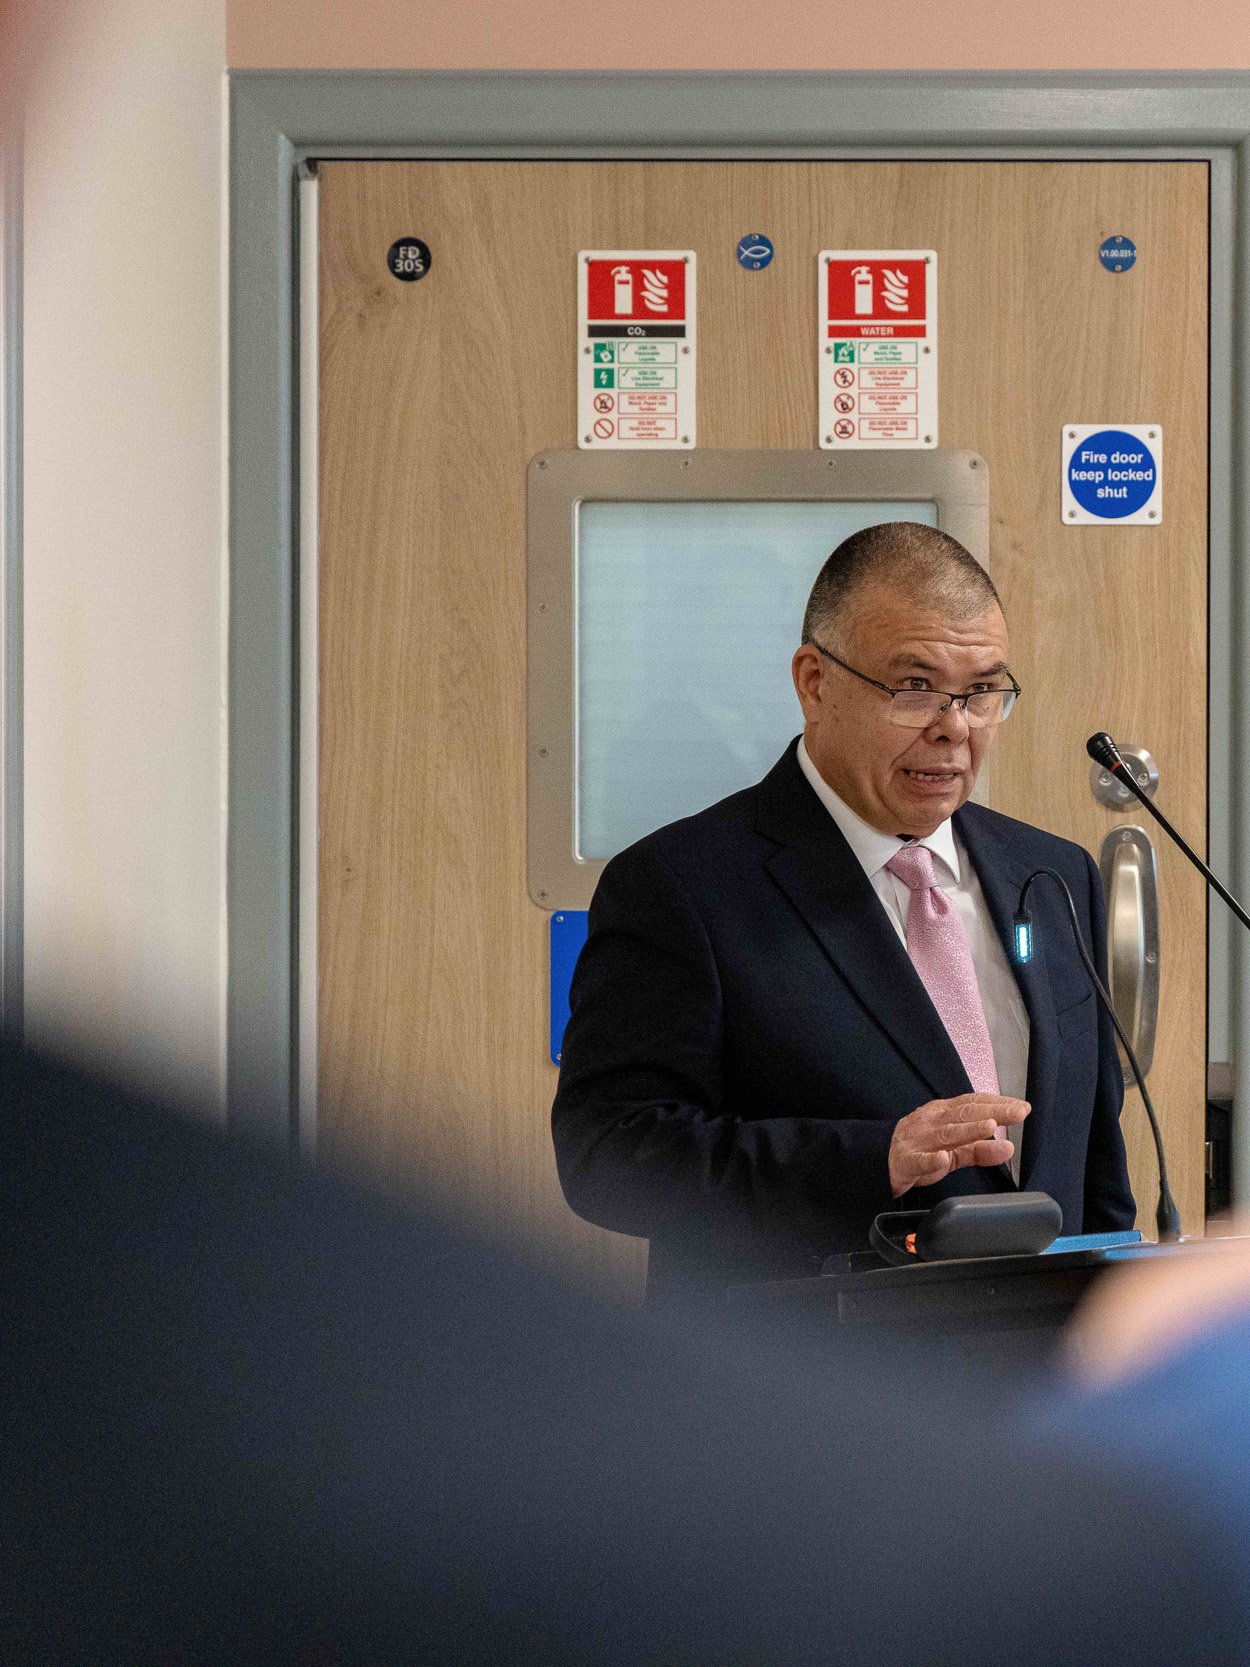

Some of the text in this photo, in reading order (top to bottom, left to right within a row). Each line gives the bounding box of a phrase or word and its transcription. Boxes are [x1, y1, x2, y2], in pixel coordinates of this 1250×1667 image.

[399, 246, 420, 259] FD
[860, 326, 894, 336] WATER
[1081, 451, 1143, 463] Fire door
[1071, 468, 1153, 483] keep locked
[1096, 486, 1128, 498] shut
